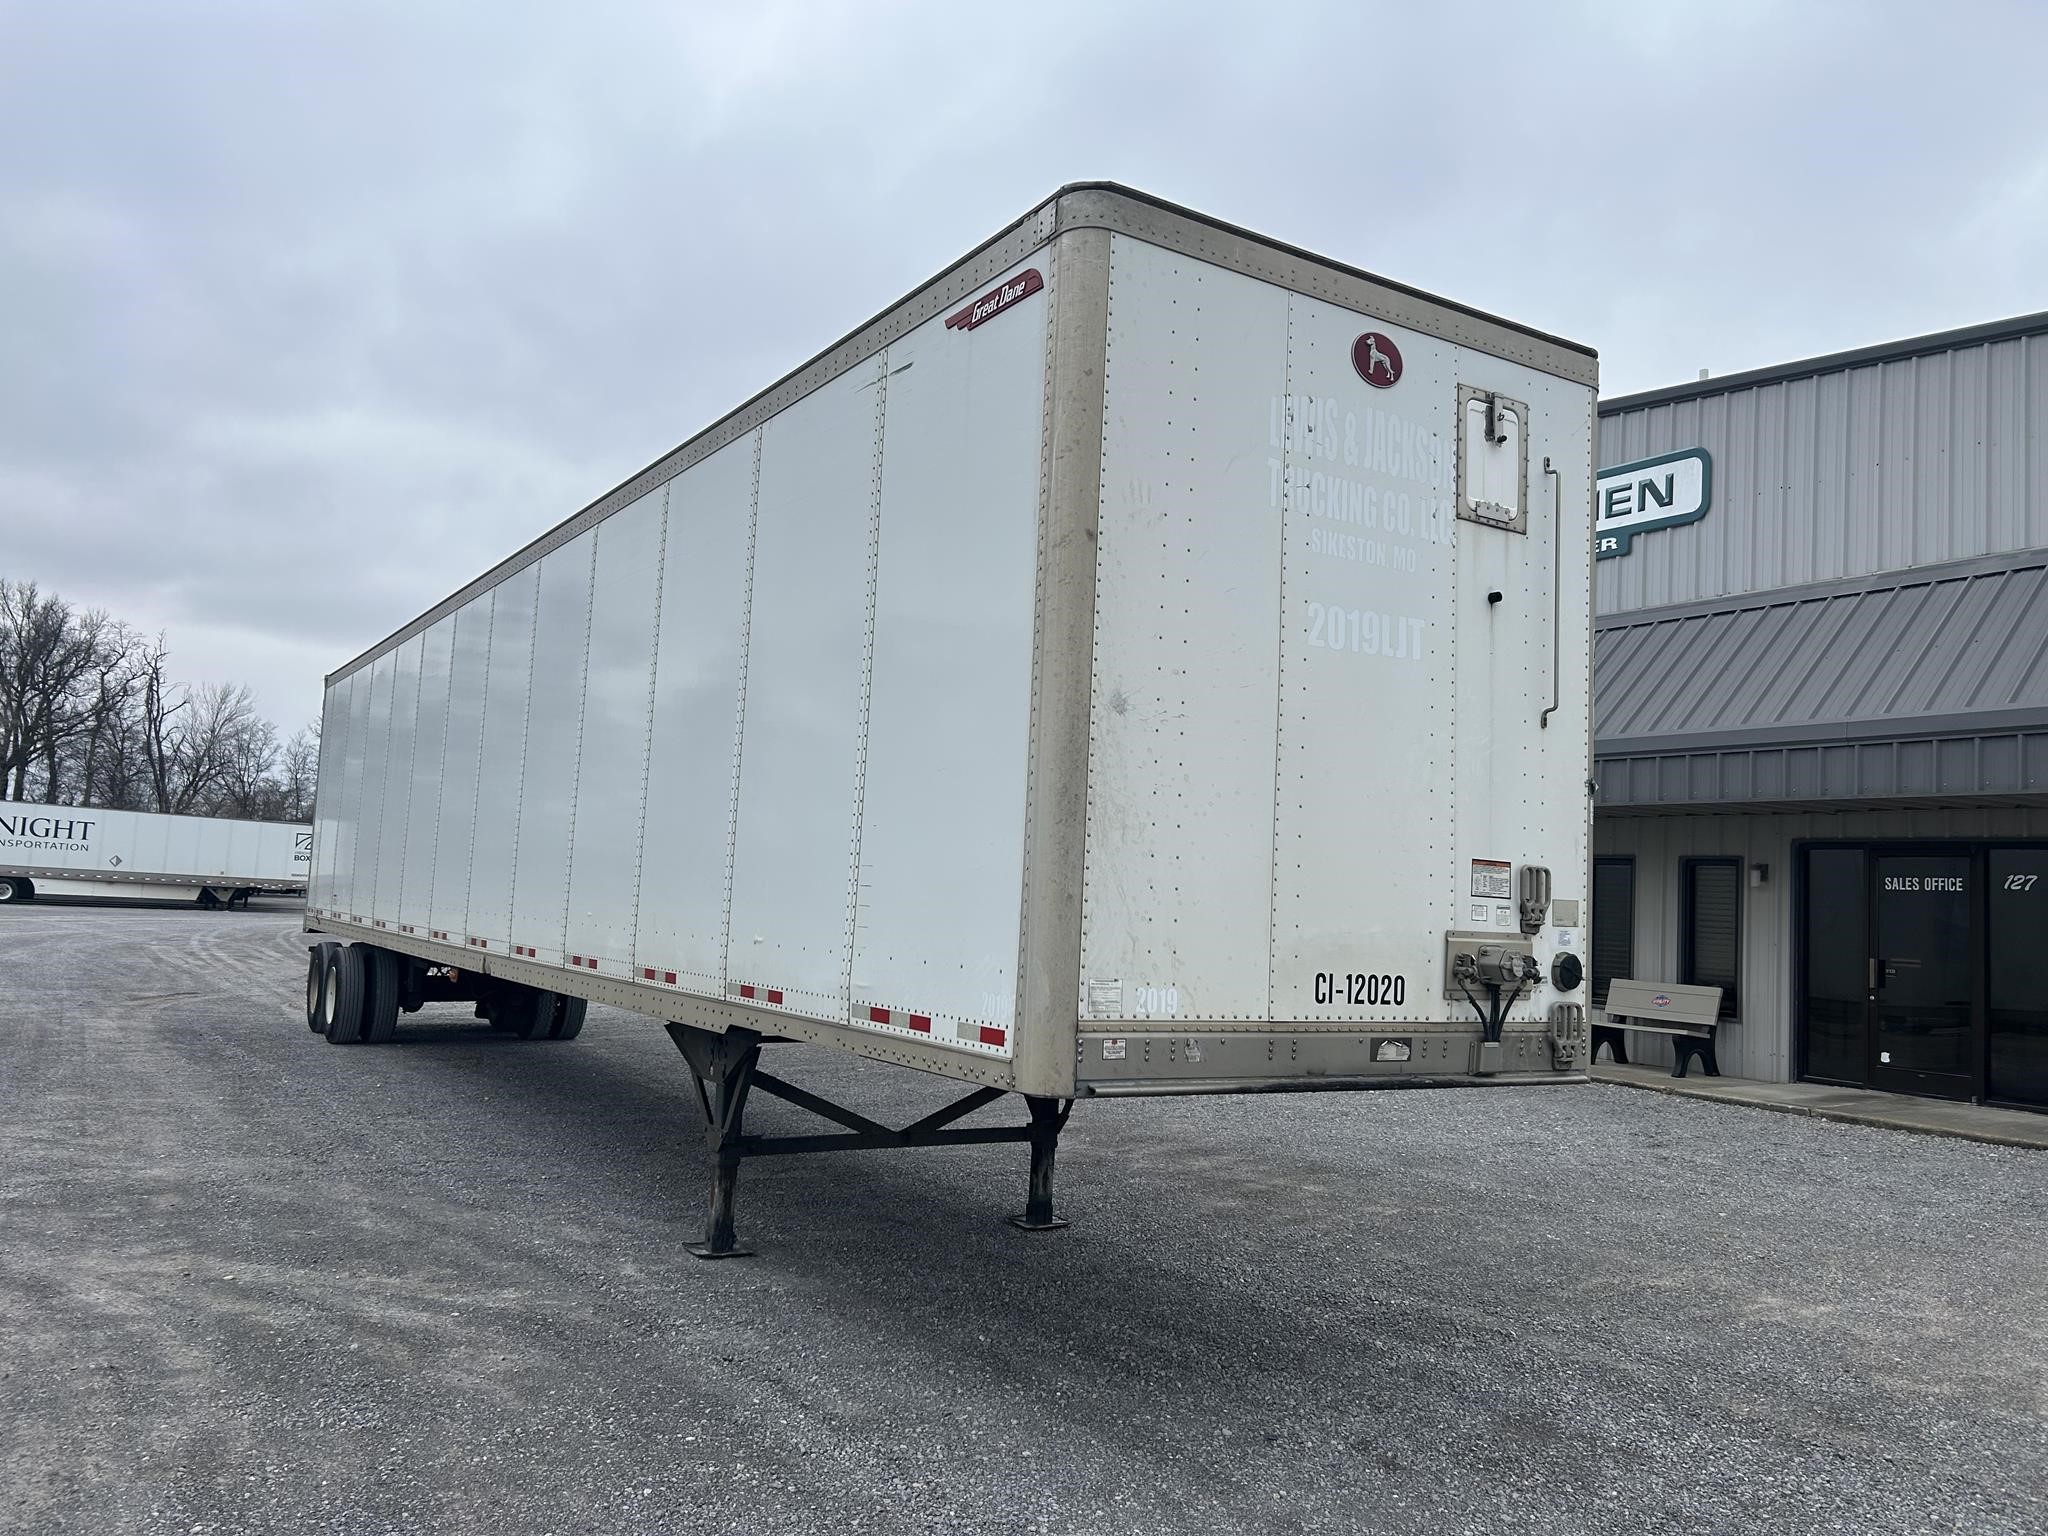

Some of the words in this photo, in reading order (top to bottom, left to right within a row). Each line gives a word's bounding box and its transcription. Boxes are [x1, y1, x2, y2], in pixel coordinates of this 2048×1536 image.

[971, 294, 1000, 324] Great
[999, 281, 1026, 306] Dane
[1343, 410, 1359, 467] &
[1596, 473, 1674, 521] EN
[1393, 544, 1418, 573] MO
[1307, 601, 1426, 660] 2019LJT
[1884, 876, 1920, 892] SALES
[1924, 876, 1963, 892] OFFICE
[2003, 874, 2039, 892] 127
[1134, 985, 1179, 1015] 2019
[1314, 972, 1406, 1006] CI-12020
